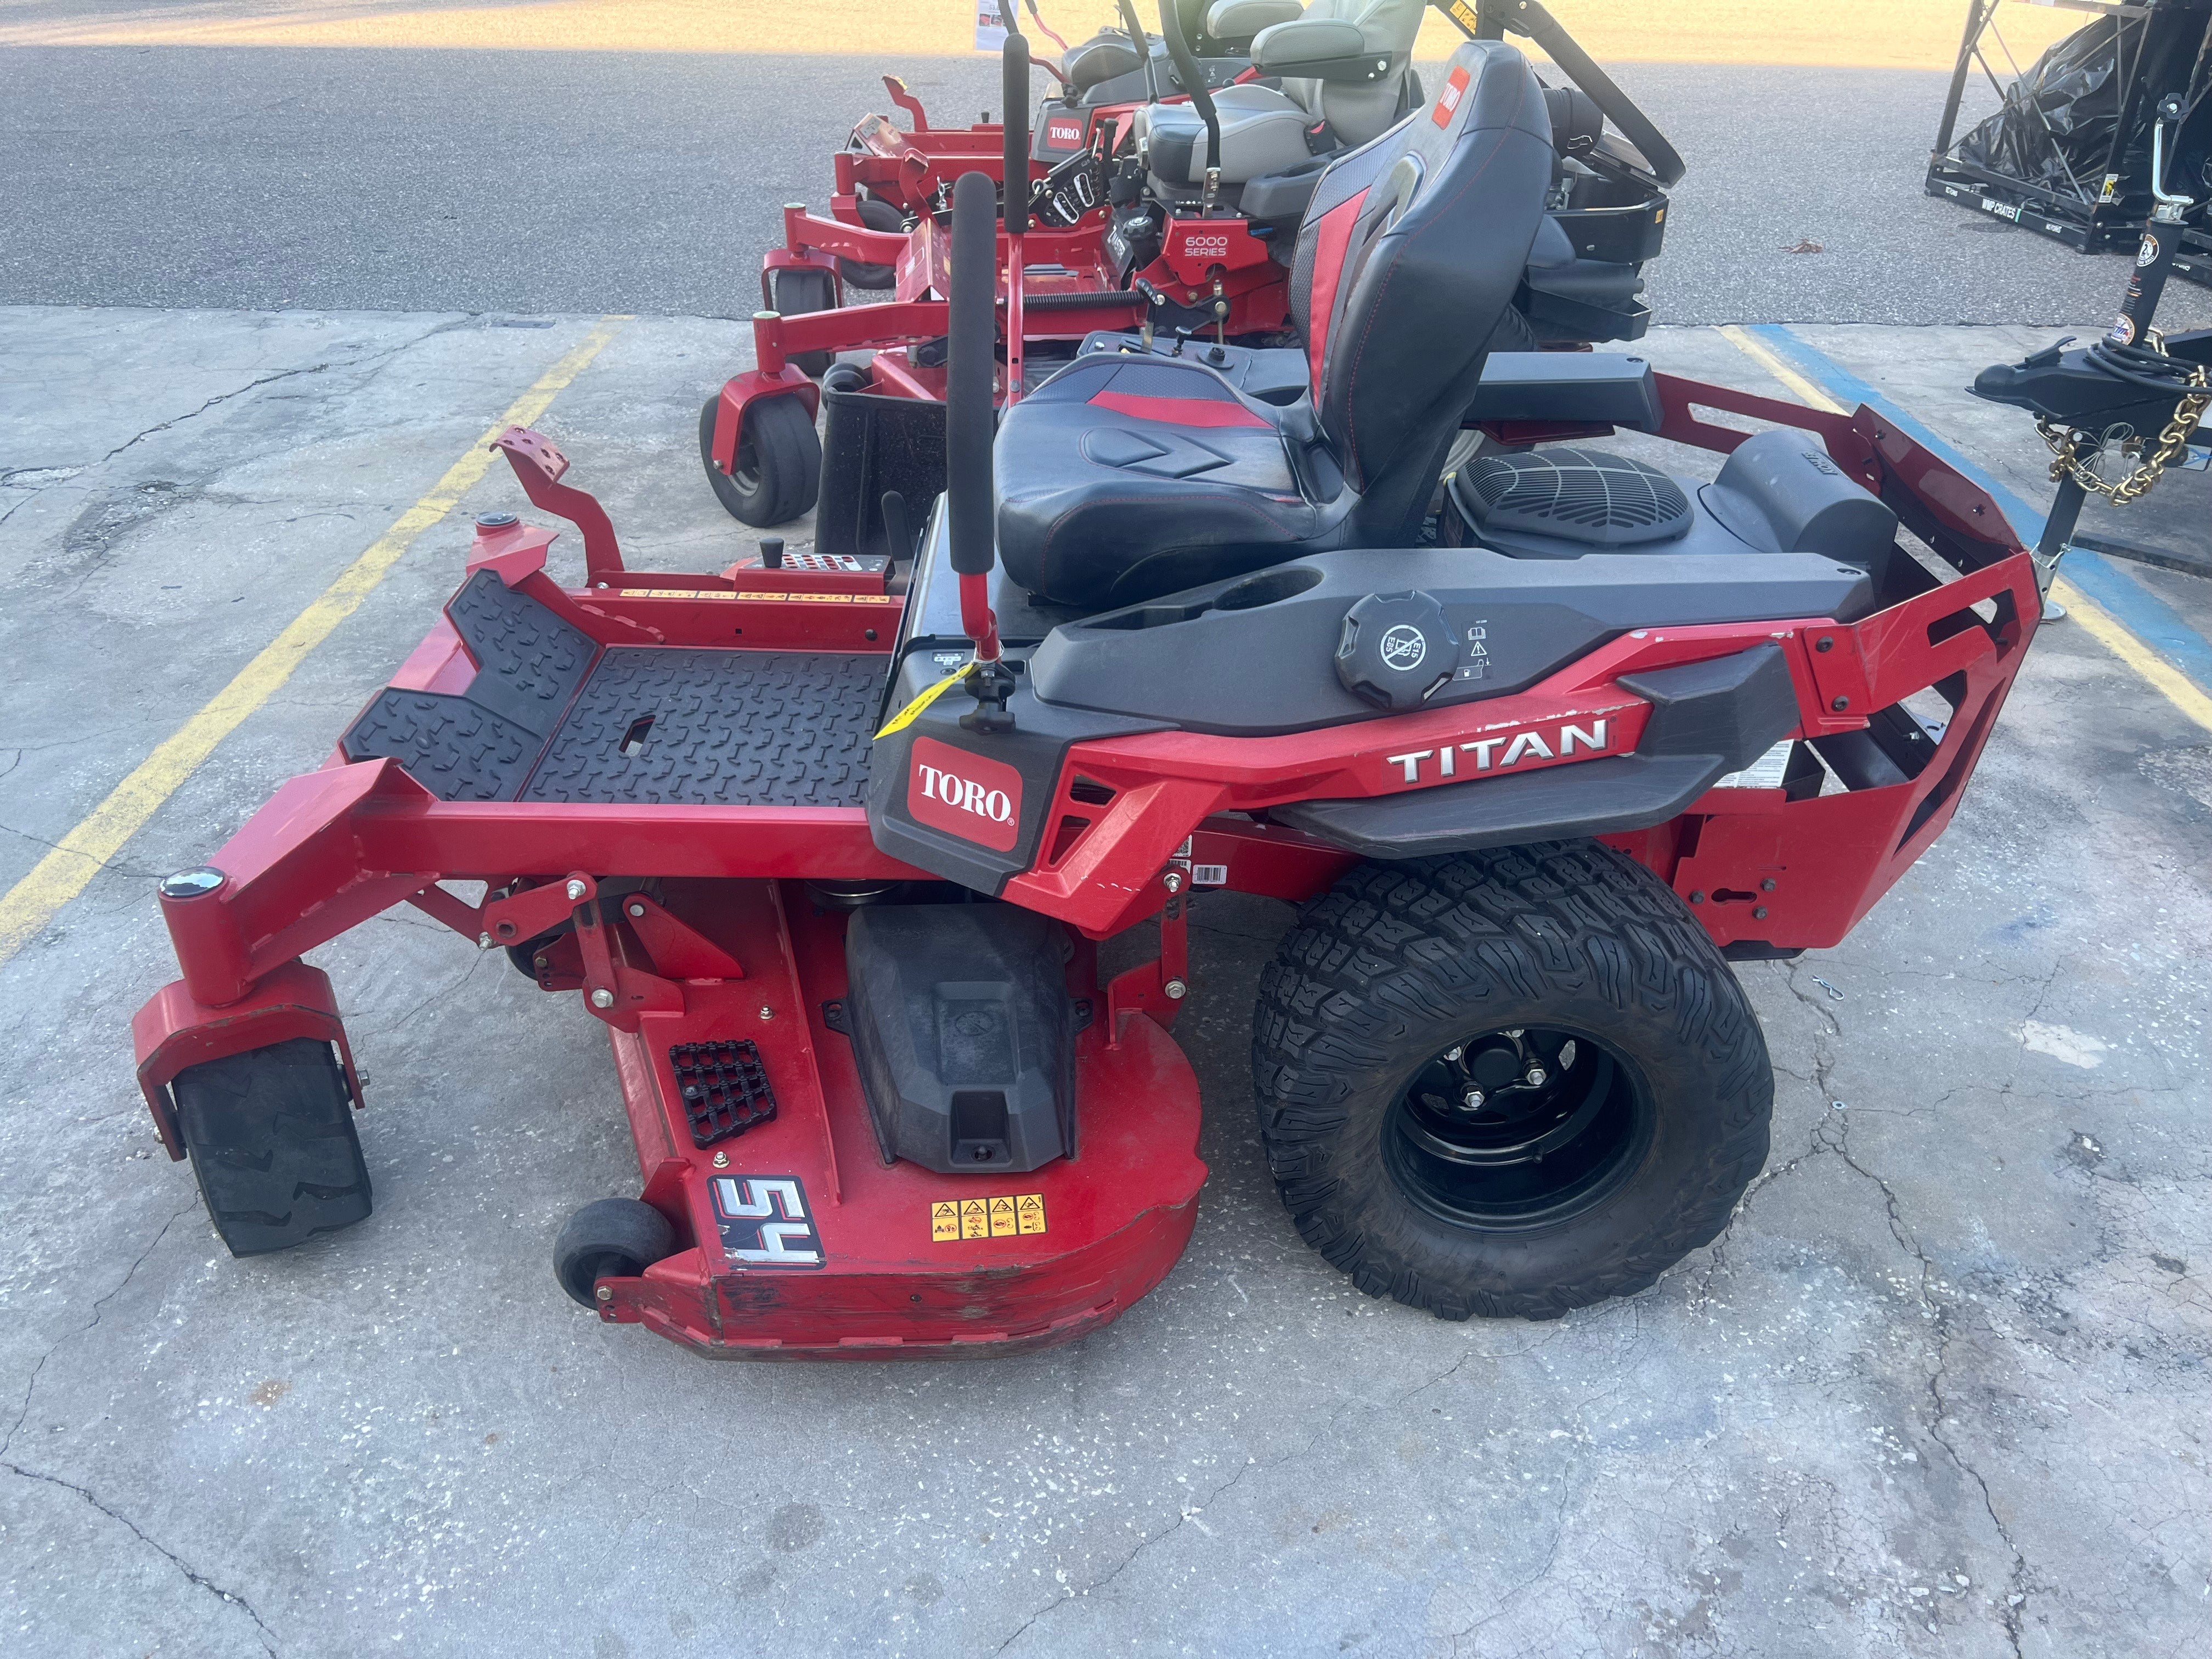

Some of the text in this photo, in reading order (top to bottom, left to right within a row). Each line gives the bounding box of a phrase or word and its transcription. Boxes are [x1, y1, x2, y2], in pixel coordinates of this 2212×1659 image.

[1439, 82, 1460, 112] TORO
[1050, 127, 1080, 140] TORO
[1994, 202, 2016, 219] CRATES
[1186, 236, 1228, 246] 6000
[1184, 247, 1227, 256] SERIES
[1385, 636, 1396, 653] E85
[1410, 642, 1421, 659] E15
[1386, 719, 1607, 784] TITAN
[918, 764, 1012, 822] TORO
[714, 1178, 820, 1264] 54
